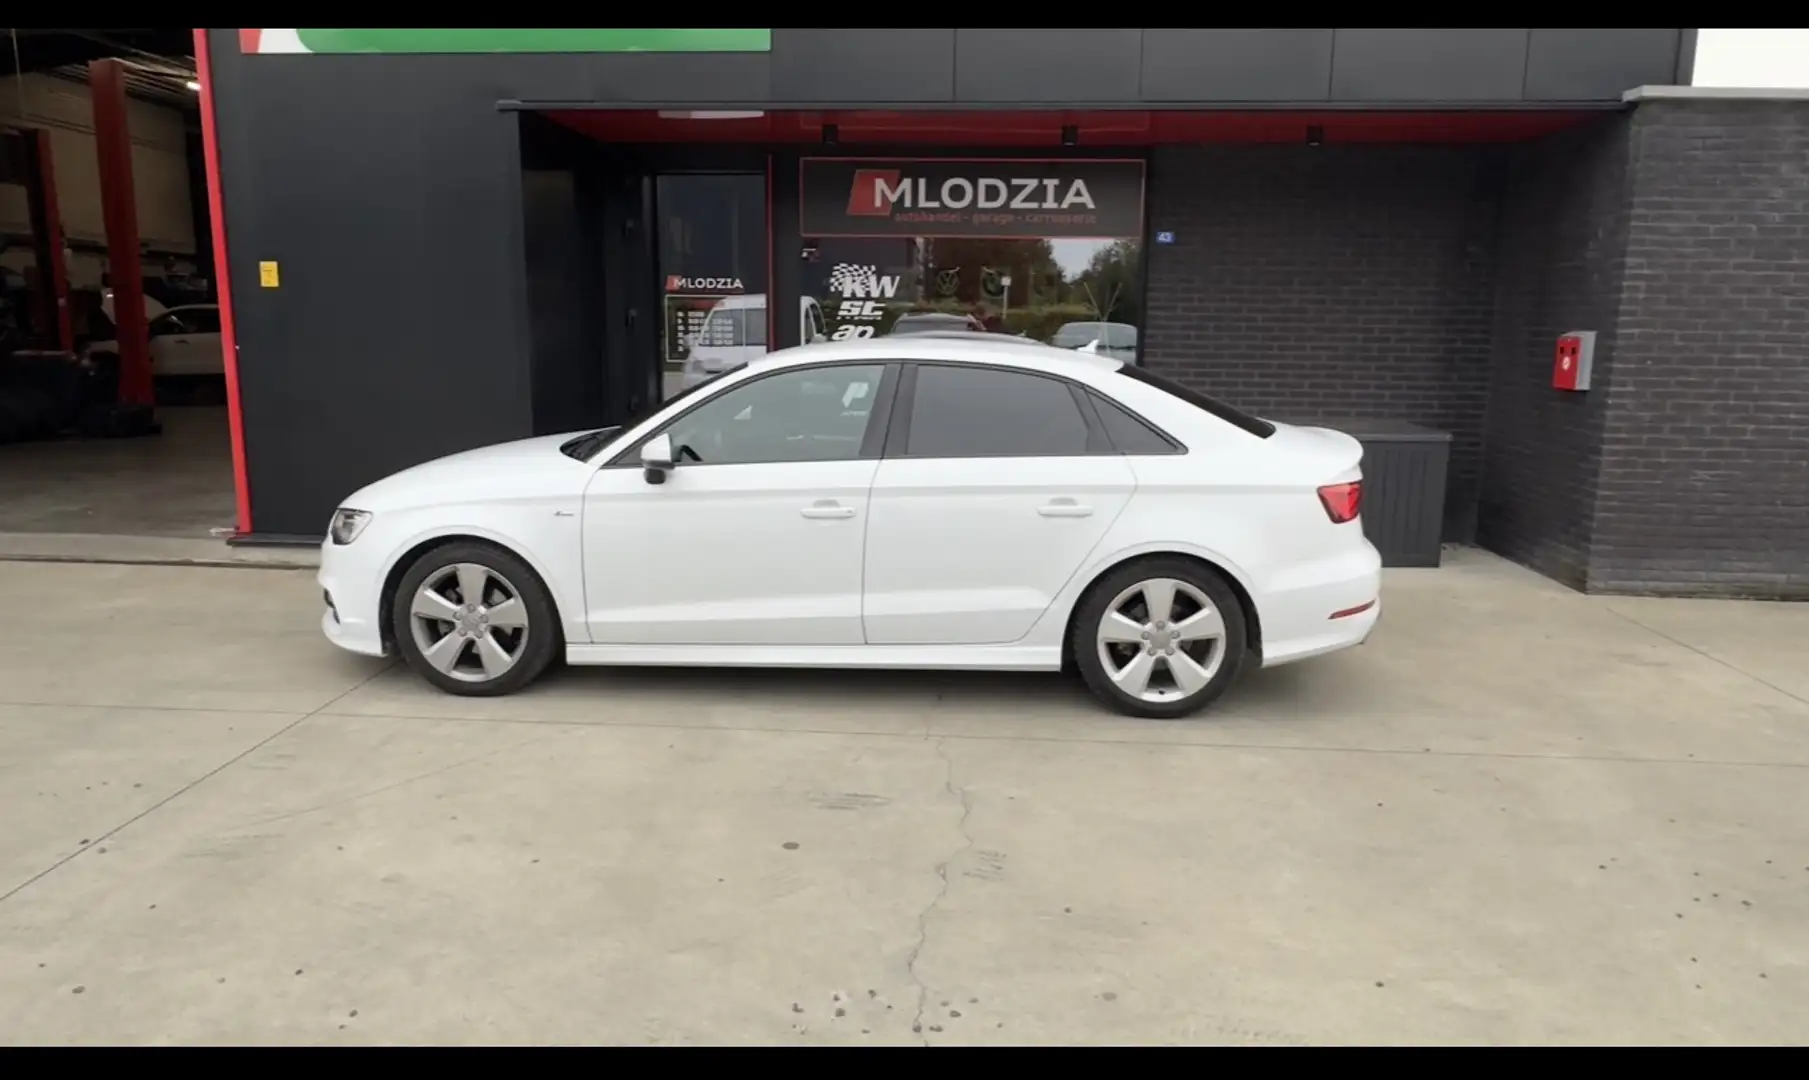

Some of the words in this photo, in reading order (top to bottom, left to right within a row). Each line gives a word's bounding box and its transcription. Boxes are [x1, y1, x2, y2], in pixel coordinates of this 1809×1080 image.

[873, 177, 1096, 210] MLODZIA
[673, 277, 744, 289] MLODZIA
[841, 275, 901, 299] KW
